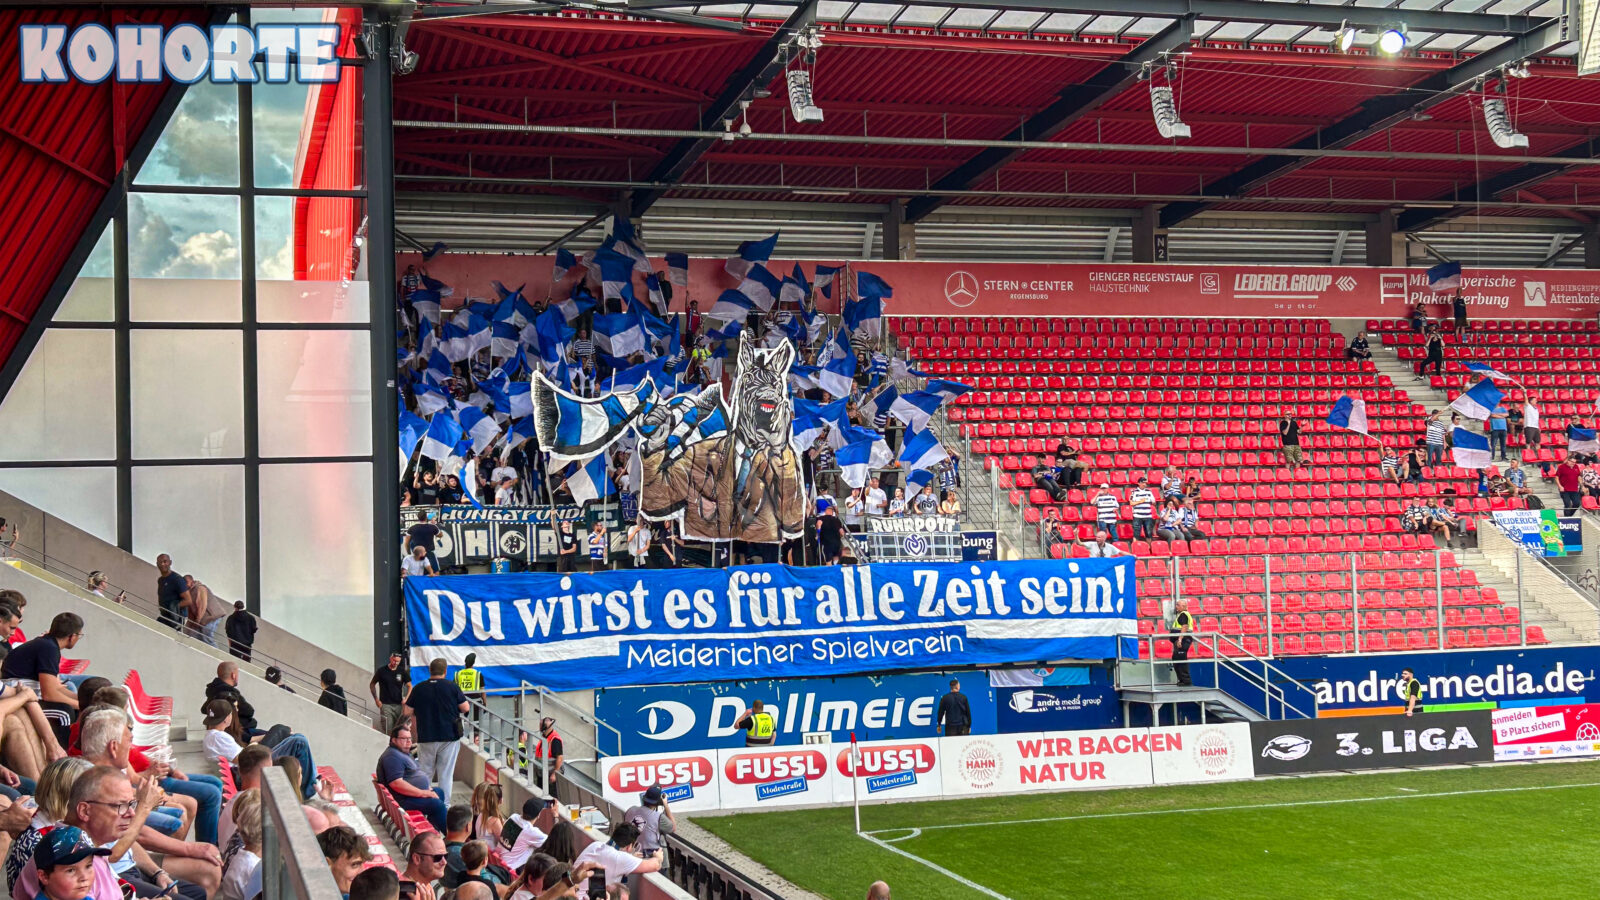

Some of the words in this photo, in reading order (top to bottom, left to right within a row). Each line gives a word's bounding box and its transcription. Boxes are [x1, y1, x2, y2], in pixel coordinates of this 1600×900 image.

[1157, 237, 1165, 247] N
[1158, 249, 1165, 259] 2
[1089, 271, 1129, 282] GIENGER
[1133, 272, 1194, 282] REGENSTAUF
[1234, 273, 1333, 292] LEDERER.GROUP
[983, 280, 1019, 291] STERN
[1030, 281, 1074, 291] CENTER
[1089, 284, 1150, 293] HAUSTECHNIK
[1410, 291, 1510, 308] Plakaterbung
[870, 517, 956, 533] RUHRPOTT
[423, 589, 505, 641] Du
[513, 576, 652, 638] wirst
[663, 588, 717, 629] es
[727, 570, 805, 628] für
[816, 565, 905, 623] alle
[912, 564, 1011, 617] Zeit
[1019, 562, 1125, 615] sein!
[627, 641, 804, 669] Meidericher
[812, 630, 964, 665] Spielverein
[1509, 725, 1530, 736] Platz
[1531, 720, 1561, 732] sichern
[1016, 738, 1073, 759] WIR
[1078, 732, 1183, 755] BACKEN
[1336, 732, 1374, 756] 3.
[1382, 726, 1479, 754] LIGA
[1200, 747, 1228, 757] HAHN
[735, 754, 820, 779] FUSSL
[966, 759, 996, 770] HAHN
[1020, 761, 1107, 784] NATUR
[619, 761, 706, 788] FUSSL
[872, 775, 912, 788] Modestraße
[761, 781, 802, 795] Modestraße
